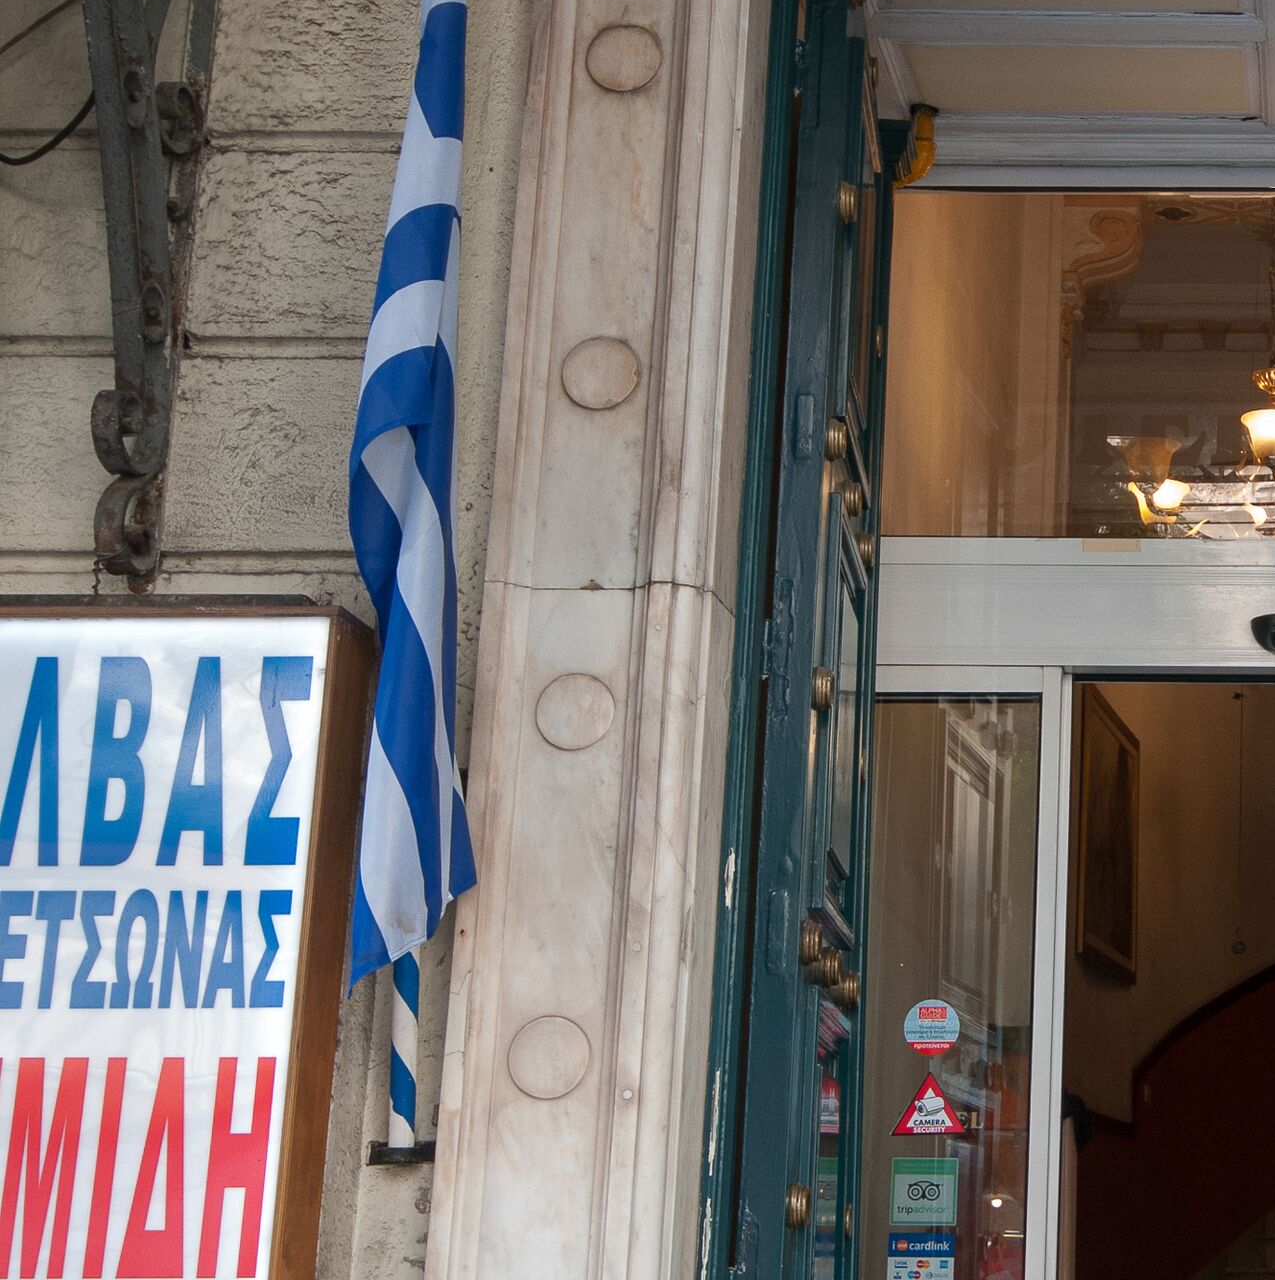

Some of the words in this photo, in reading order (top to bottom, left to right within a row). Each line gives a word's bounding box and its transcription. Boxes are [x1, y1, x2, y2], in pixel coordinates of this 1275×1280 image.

[0, 656, 314, 866] ΛΒΑΣ
[0, 888, 293, 1009] ΕΤΣΩΝΑΣ
[897, 1204, 946, 1216] tripadvisor
[909, 1240, 951, 1251] cardlink
